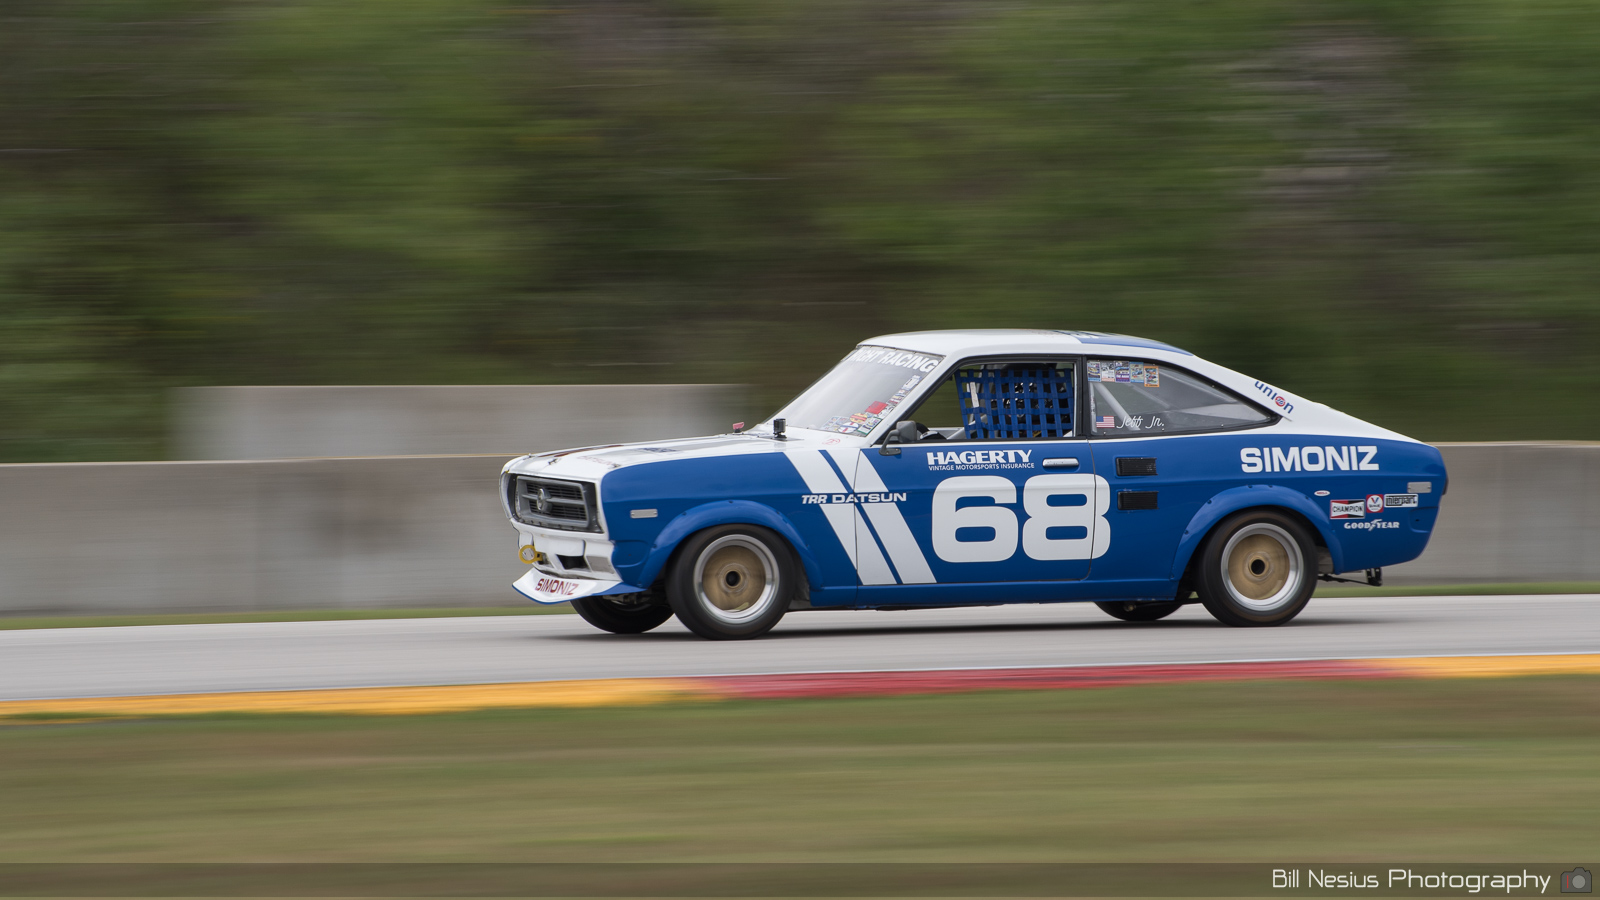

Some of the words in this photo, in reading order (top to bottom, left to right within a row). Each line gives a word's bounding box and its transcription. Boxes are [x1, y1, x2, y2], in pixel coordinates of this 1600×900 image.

[877, 351, 939, 373] RACING
[1116, 415, 1143, 429] Jeff
[926, 449, 1032, 466] HAGERTY
[1240, 445, 1380, 473] SIMONIZ
[955, 463, 1000, 471] MOTORSPORTS
[801, 494, 828, 504] TRR
[831, 492, 907, 503] DATSUN
[1332, 505, 1364, 513] CHAMPION
[931, 473, 1111, 563] 68
[535, 578, 579, 596] SIMONIZ
